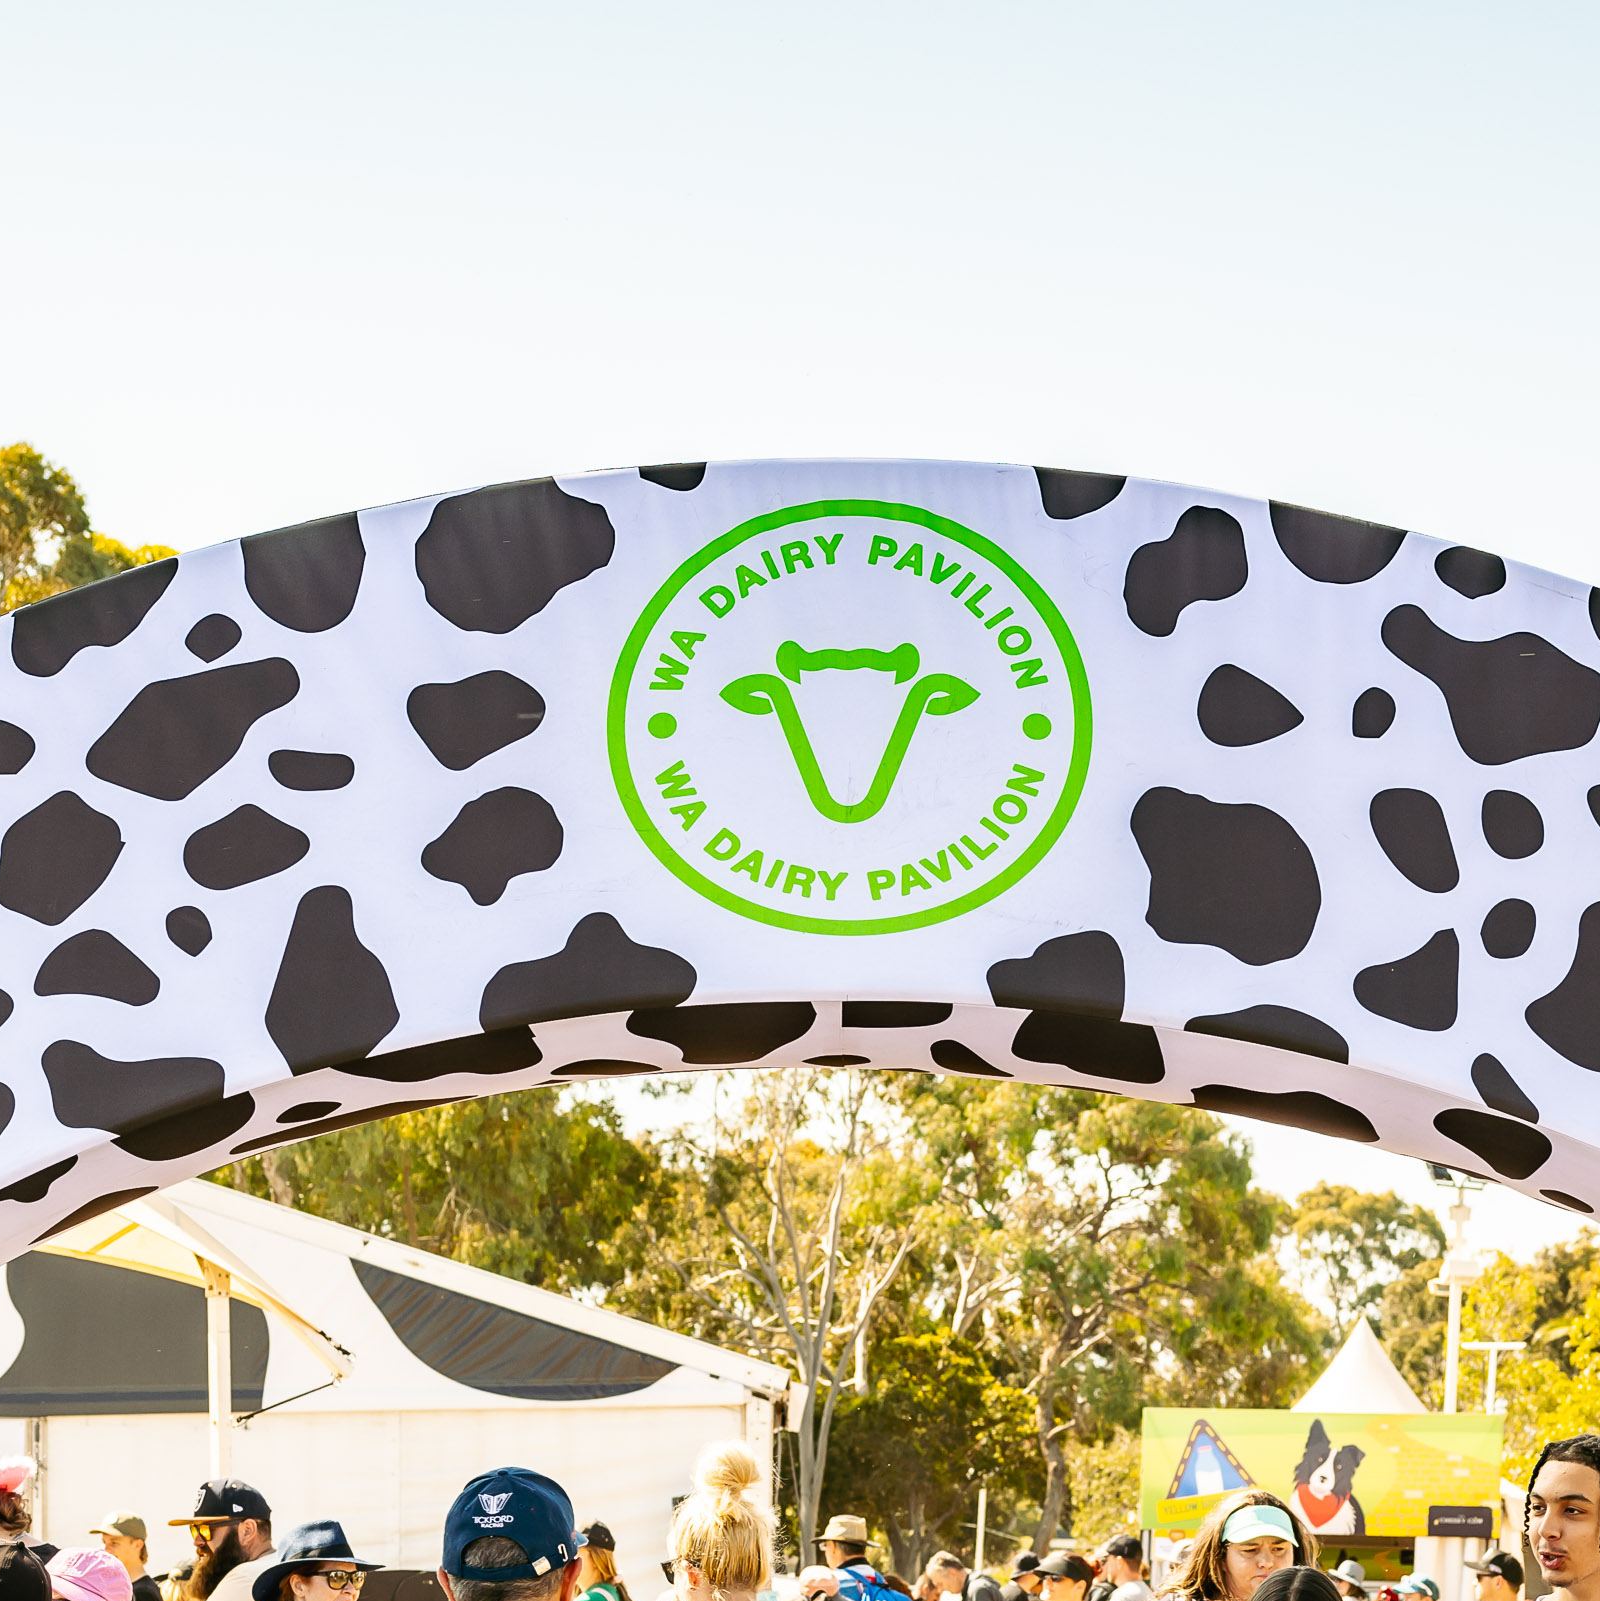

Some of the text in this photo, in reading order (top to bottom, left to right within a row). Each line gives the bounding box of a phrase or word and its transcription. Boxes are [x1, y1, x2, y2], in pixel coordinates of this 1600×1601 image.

[649, 534, 1048, 690] WA DAIRY PAVILION
[655, 760, 1045, 900] WA DAIRY PAVILION
